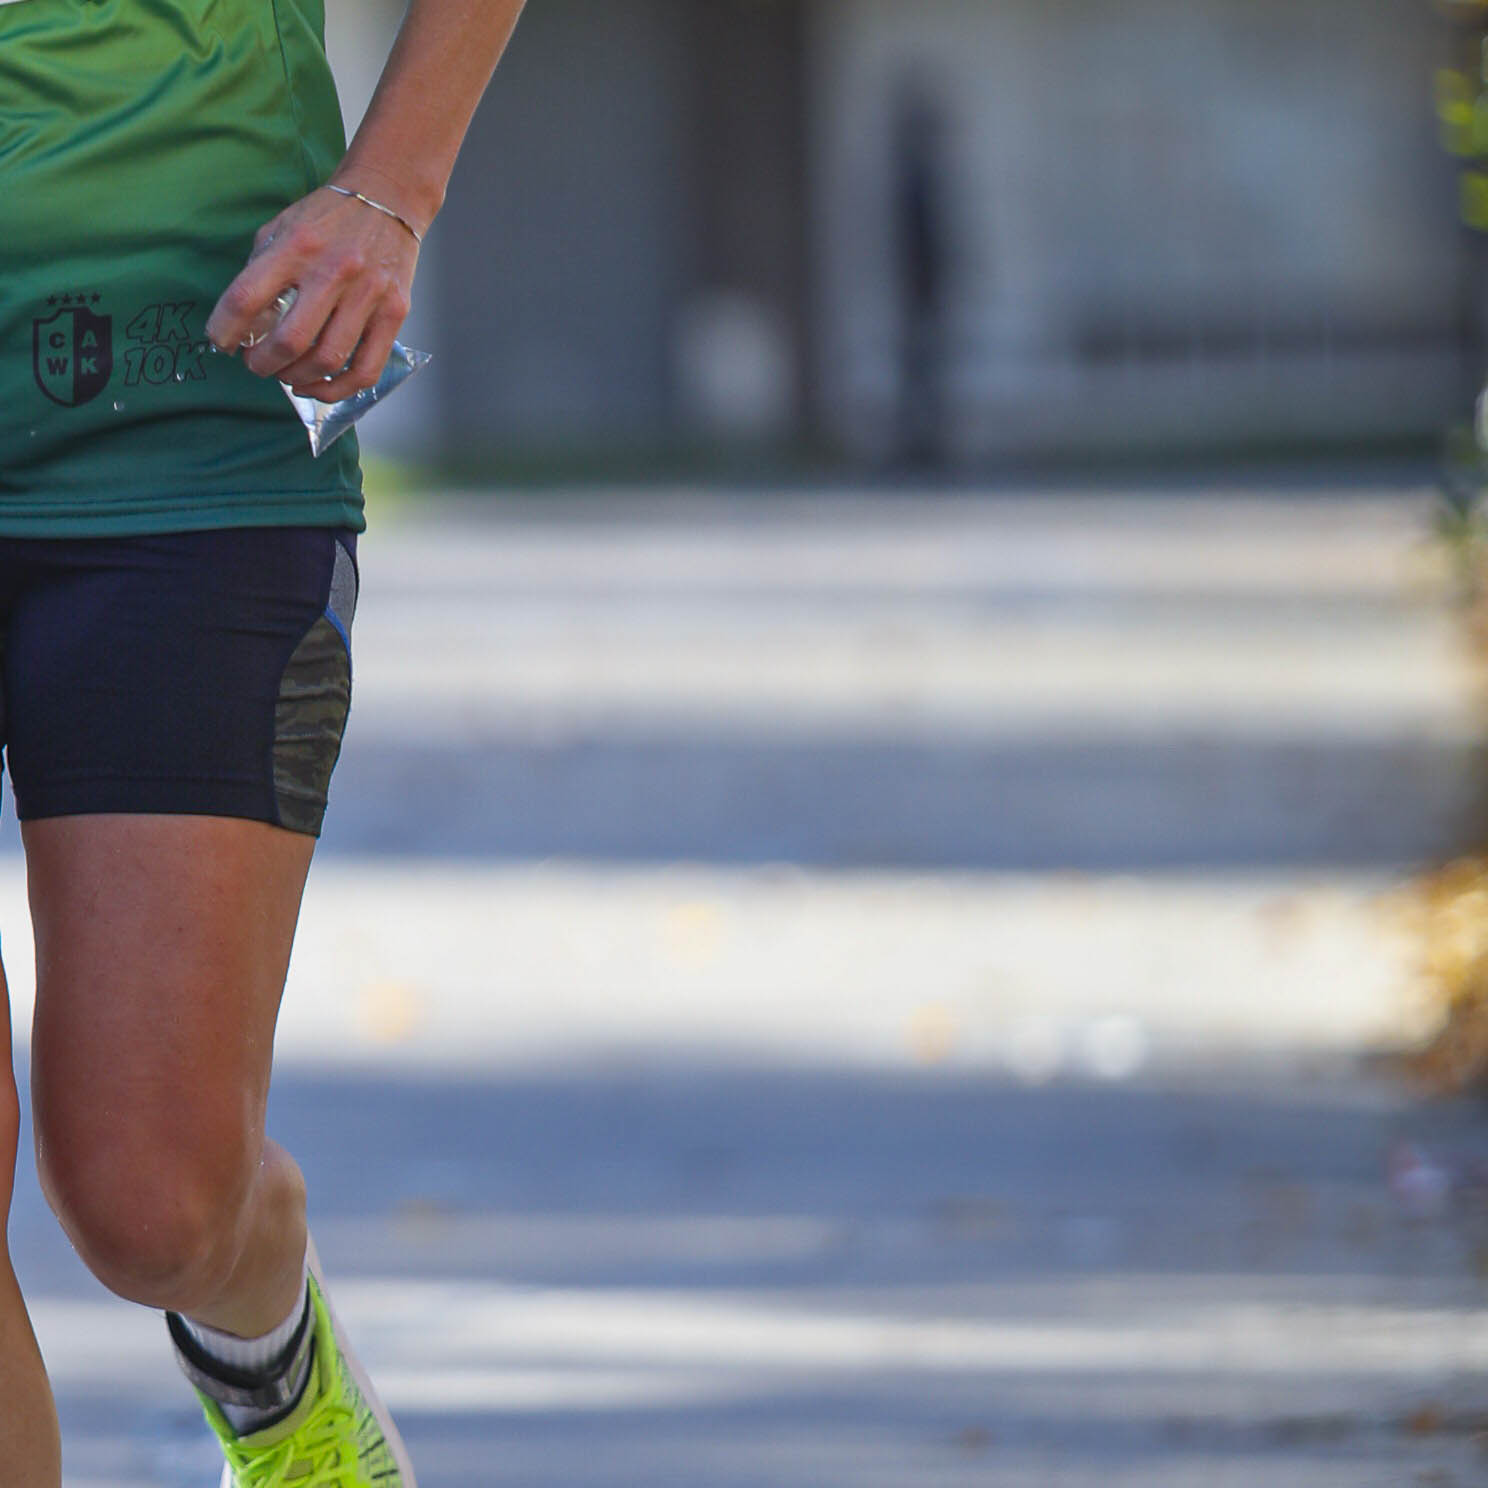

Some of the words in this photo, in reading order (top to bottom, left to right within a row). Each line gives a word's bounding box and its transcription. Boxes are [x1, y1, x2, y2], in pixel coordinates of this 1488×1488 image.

[49, 332, 65, 349] C
[81, 329, 98, 348] A
[126, 301, 196, 345] 4K
[47, 357, 69, 377] W
[81, 357, 98, 376] K
[124, 341, 213, 387] 10K
